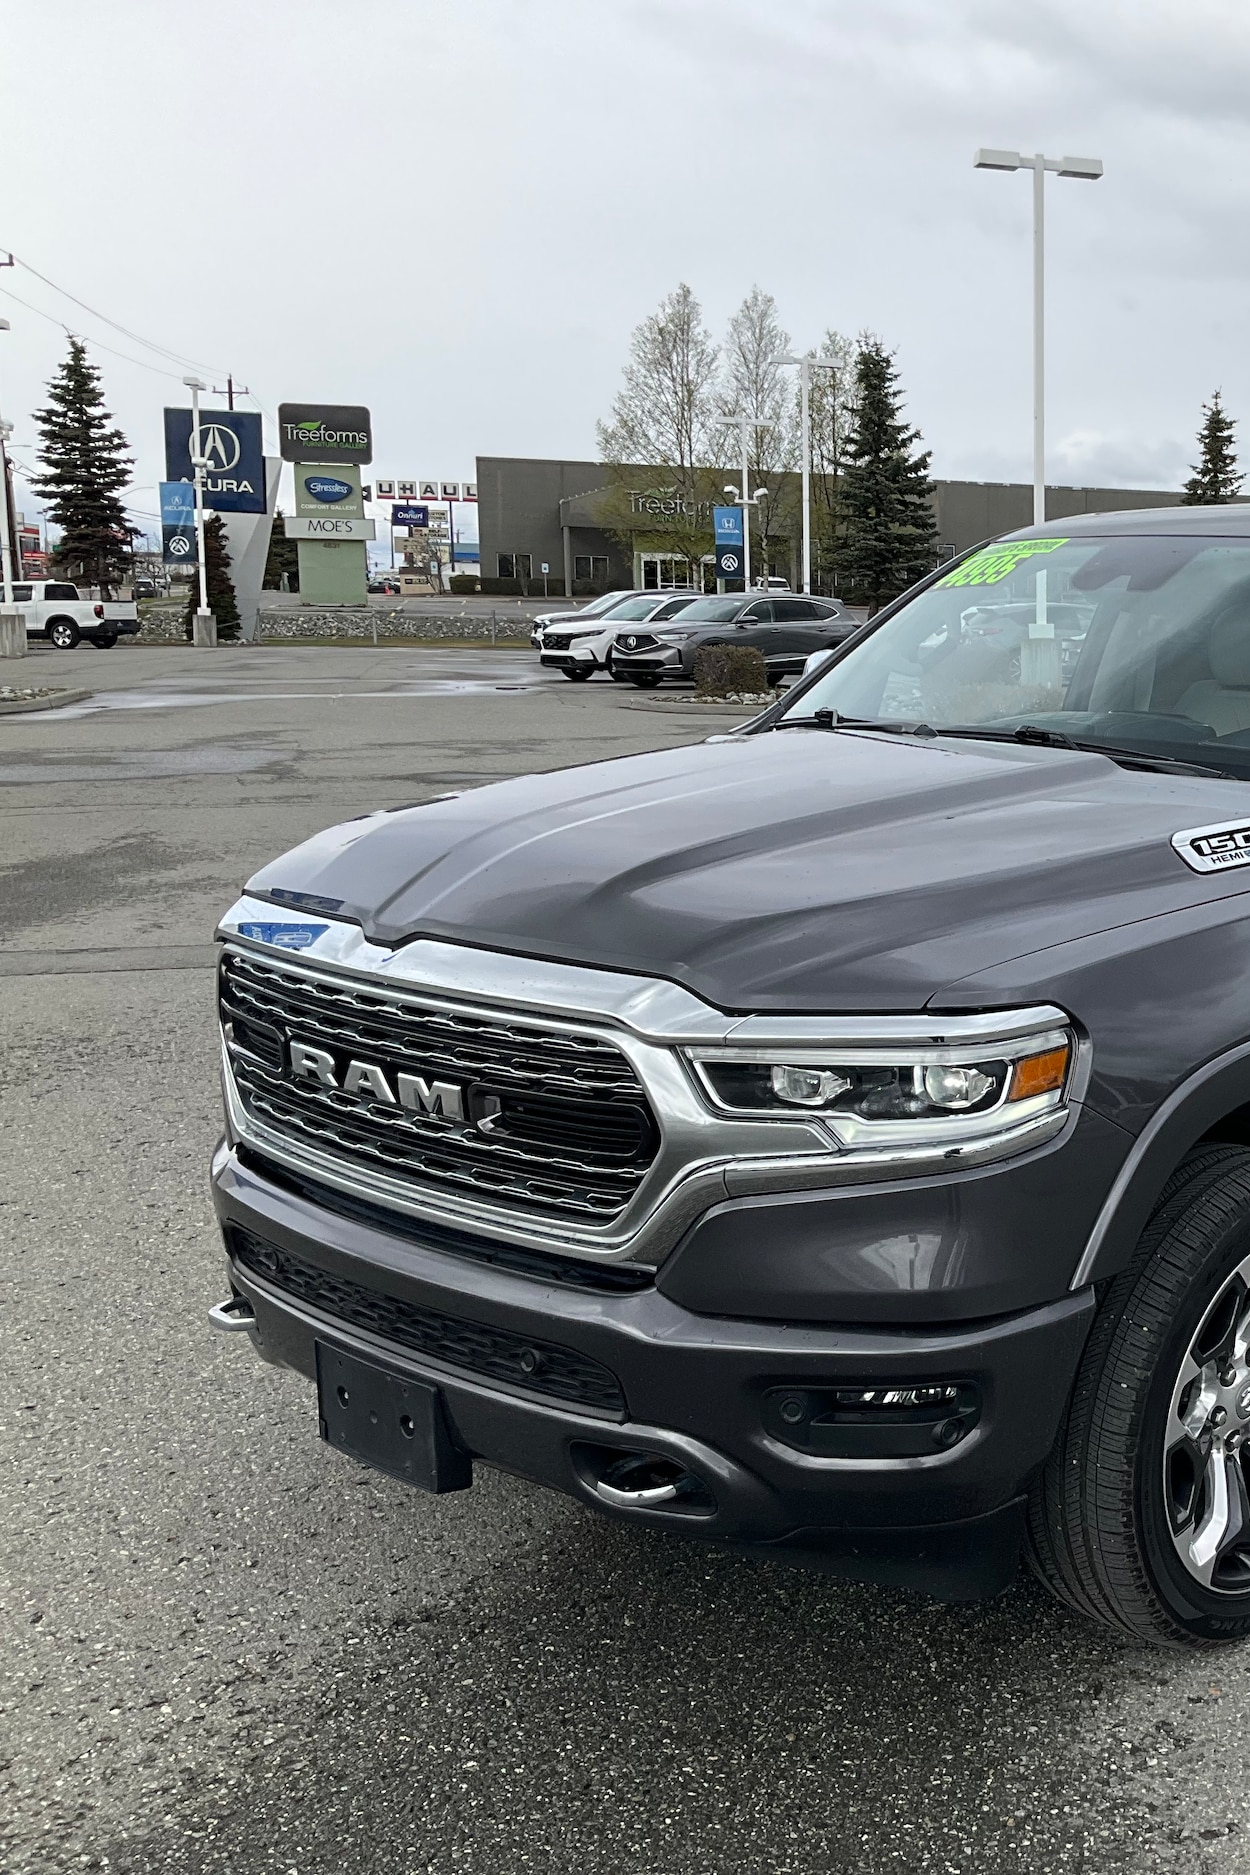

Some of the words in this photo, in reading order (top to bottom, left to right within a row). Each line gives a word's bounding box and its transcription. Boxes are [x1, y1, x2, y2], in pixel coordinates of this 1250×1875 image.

[282, 423, 368, 444] Treeforms
[310, 483, 348, 494] Stressless
[308, 520, 353, 532] MOE'S
[1211, 852, 1243, 864] HEMI
[290, 1040, 465, 1121] RAM
